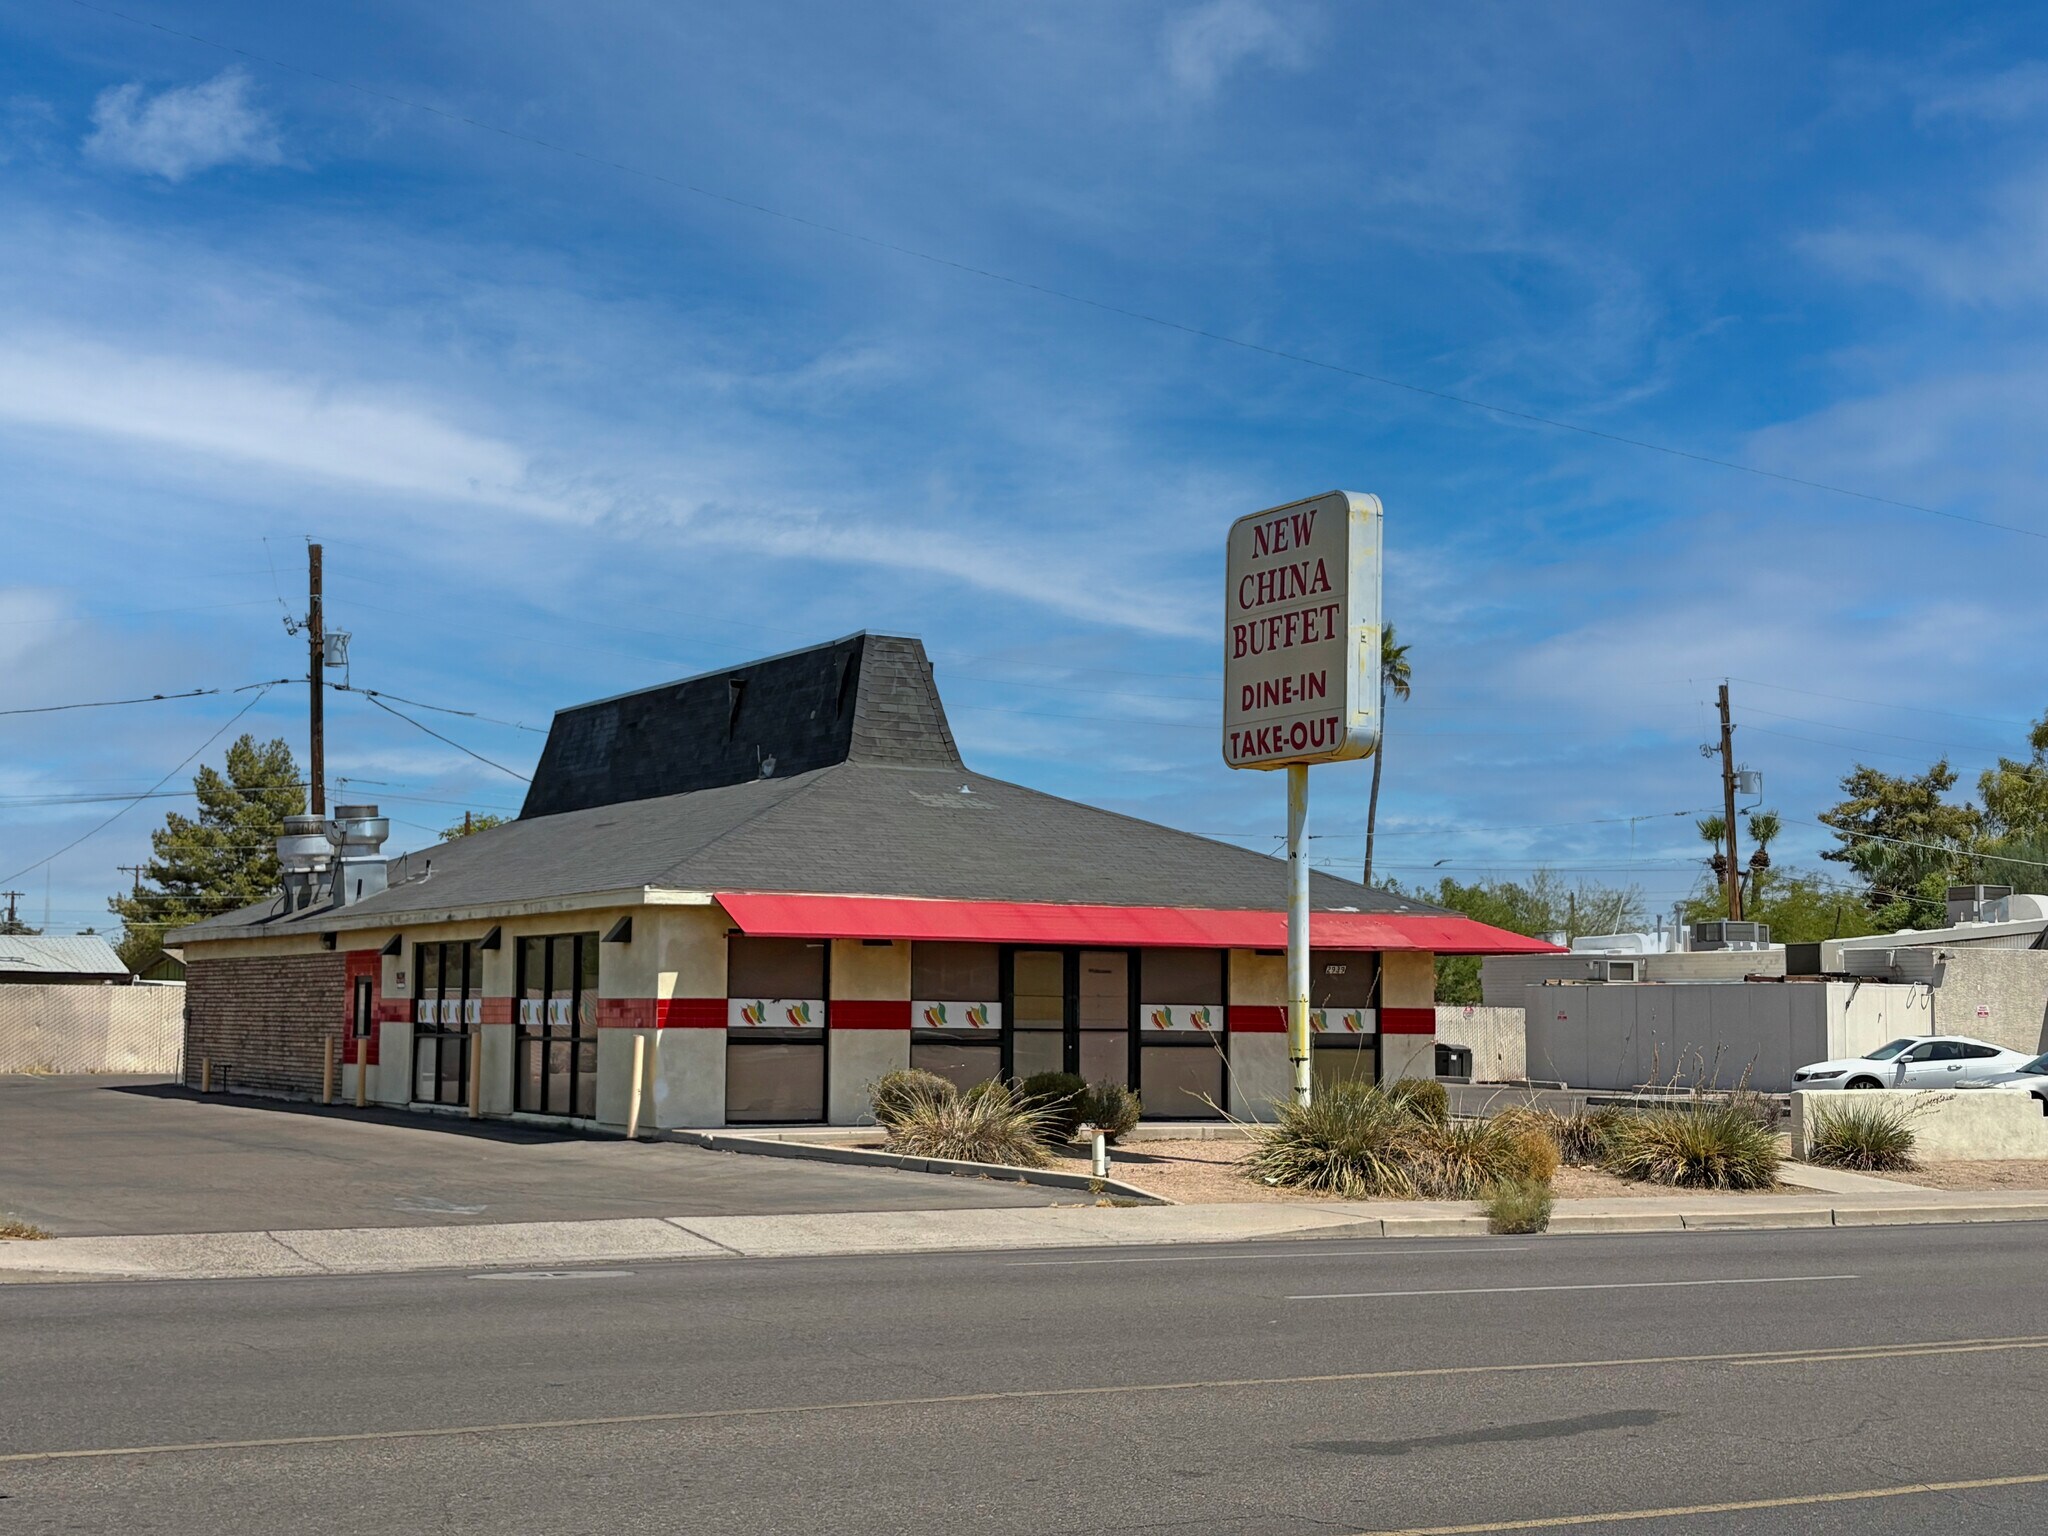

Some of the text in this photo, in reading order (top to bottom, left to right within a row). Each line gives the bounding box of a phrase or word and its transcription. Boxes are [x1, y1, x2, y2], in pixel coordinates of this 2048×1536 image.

[1252, 509, 1317, 559] NEW
[1239, 557, 1331, 609] CHINA
[1233, 603, 1339, 659] BUFFET
[1242, 670, 1326, 711] DINE-IN
[1231, 717, 1338, 759] TAKE-OUT
